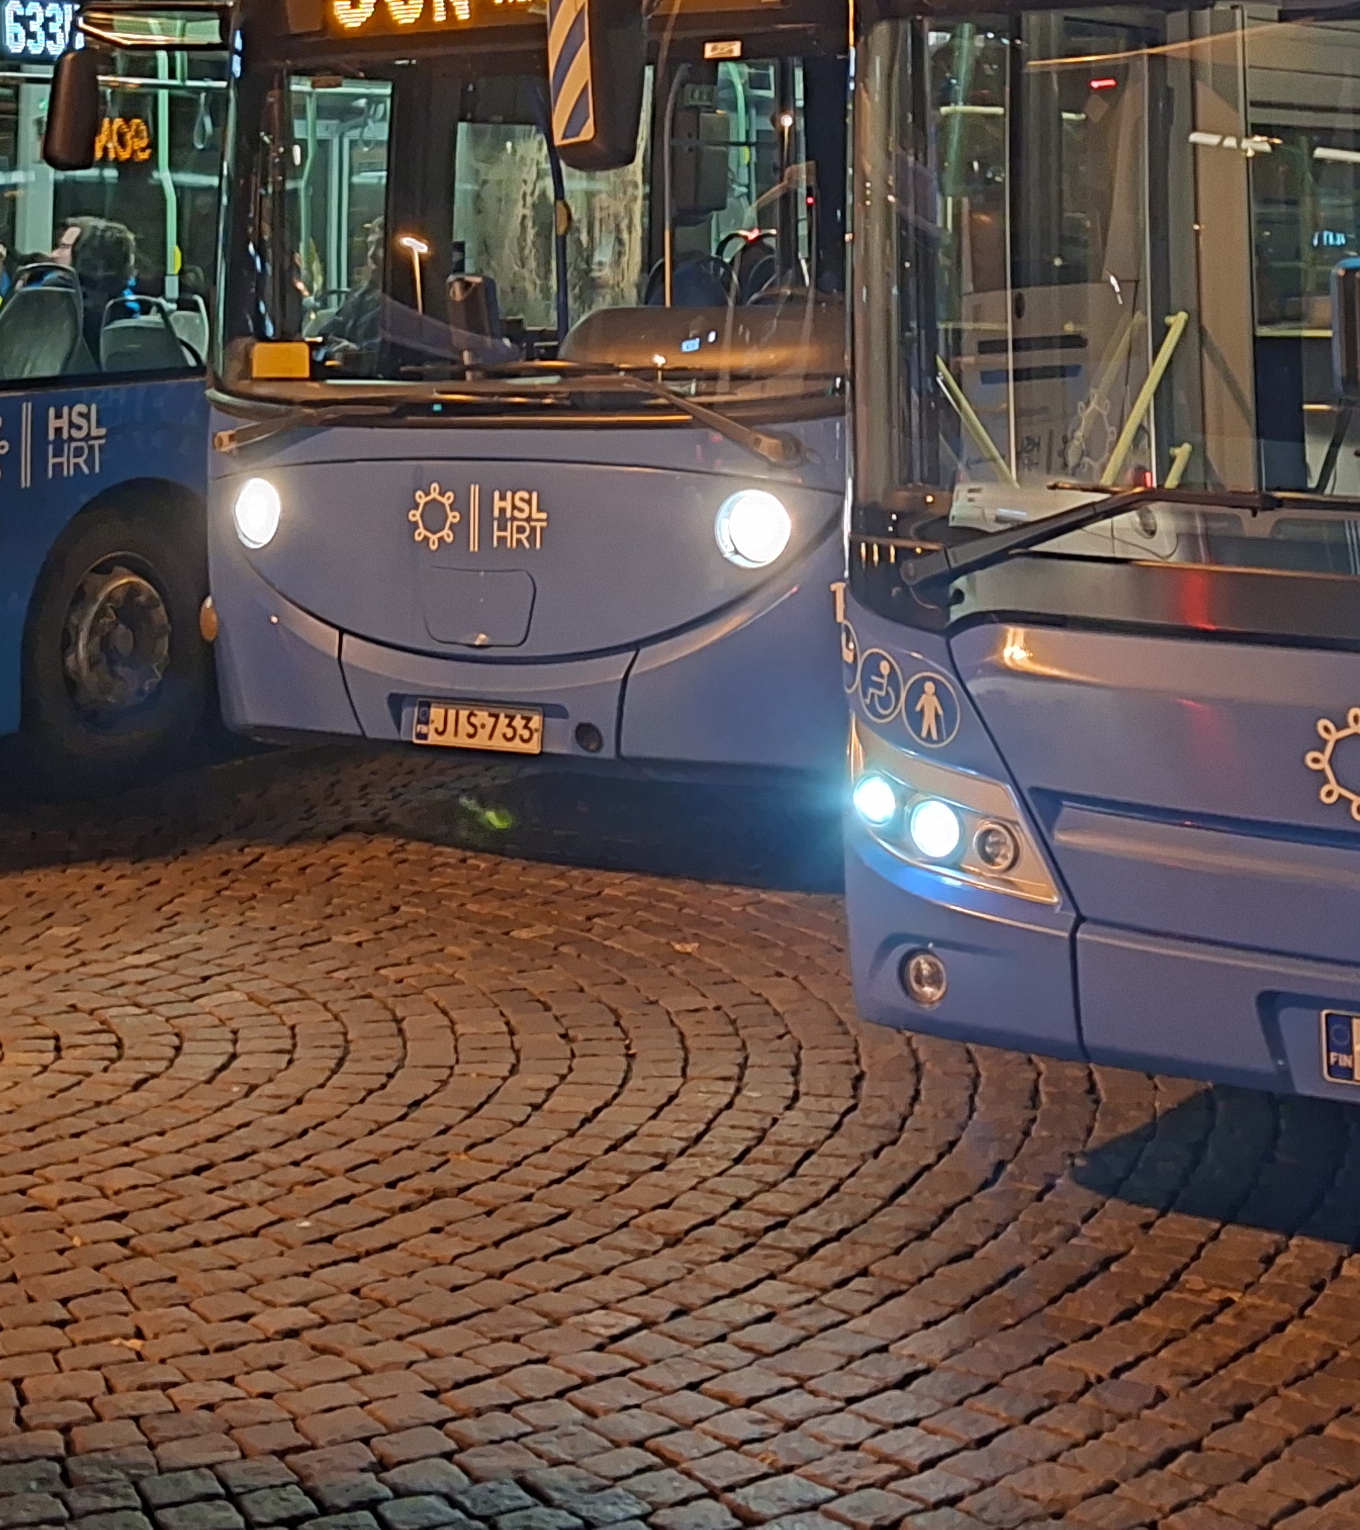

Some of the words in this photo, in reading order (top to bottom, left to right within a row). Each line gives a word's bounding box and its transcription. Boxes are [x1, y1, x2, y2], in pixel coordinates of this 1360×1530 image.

[48, 403, 107, 441] HSL
[48, 439, 106, 479] HRT
[492, 489, 548, 520] HSL
[492, 519, 547, 550] HRT
[434, 708, 534, 744] JIS-733
[1329, 1052, 1353, 1068] FIN
